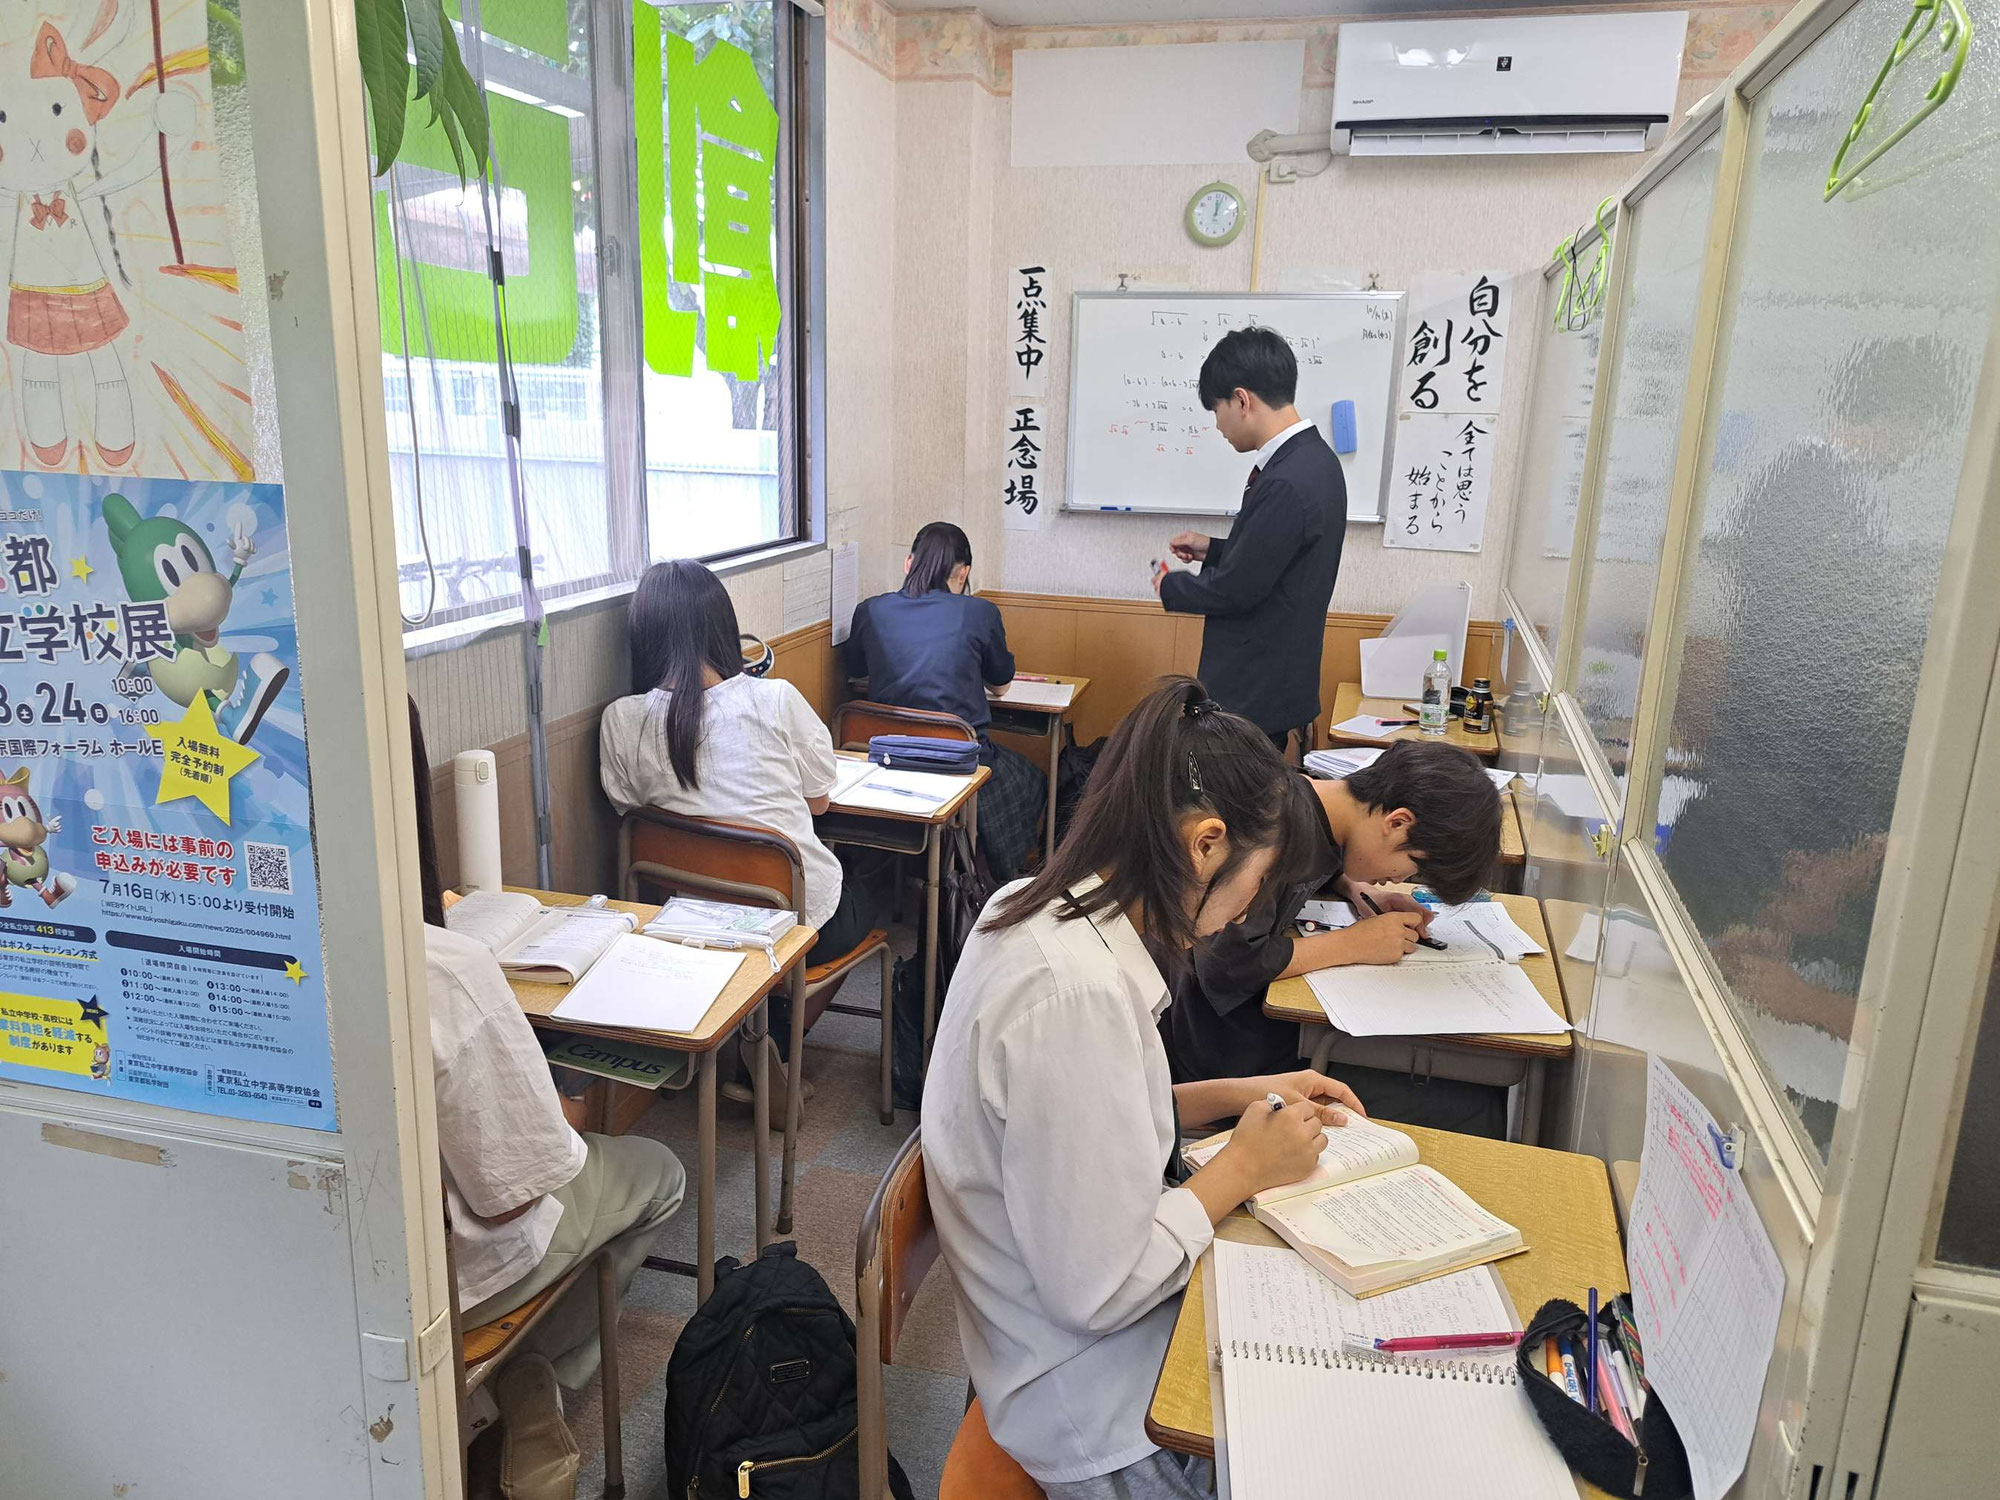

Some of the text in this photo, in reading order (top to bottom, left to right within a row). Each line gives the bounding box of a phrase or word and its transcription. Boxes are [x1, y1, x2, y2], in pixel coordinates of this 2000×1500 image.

[1015, 266, 1046, 380] 一点集中
[1461, 275, 1503, 402] 自分を
[1407, 318, 1453, 409] 創る
[1003, 407, 1042, 515] 正念場
[1454, 420, 1490, 524] 全ては思う
[1404, 465, 1431, 535] 始まる
[1429, 450, 1453, 534] ことから
[111, 678, 153, 693] 10:00
[118, 709, 159, 723] 16:00
[110, 740, 164, 756] ホールE
[170, 751, 225, 776] 完全予約制
[177, 736, 219, 759] 入場無料
[92, 825, 234, 860] ご入場には事前の
[95, 852, 237, 887] 申込みが必要です
[567, 1043, 666, 1074] Campus
[216, 1074, 321, 1098] 東京私立中学高等学校協会
